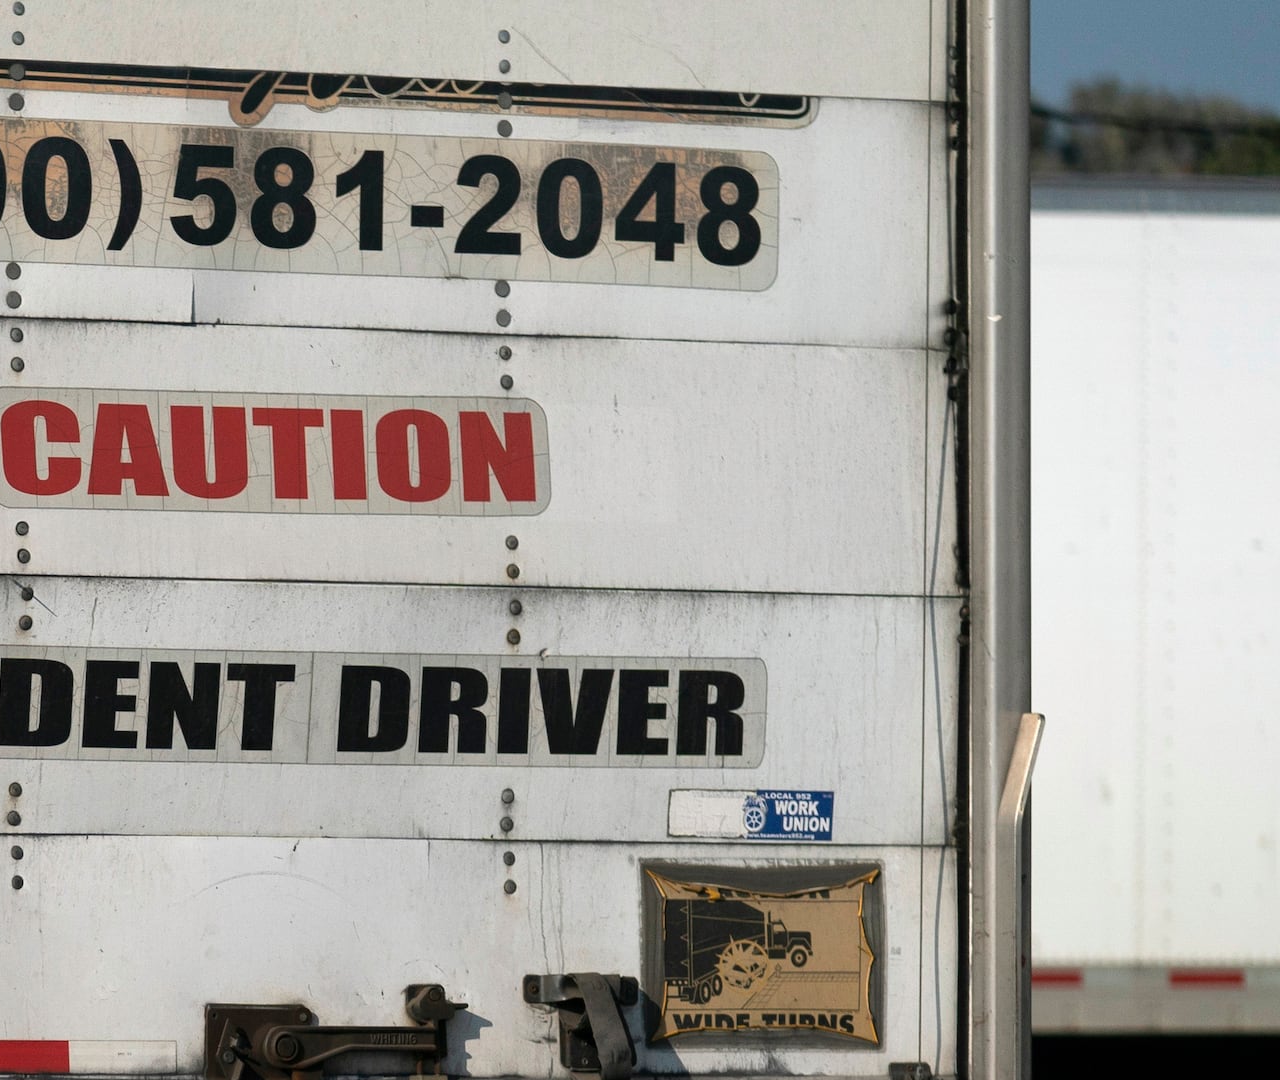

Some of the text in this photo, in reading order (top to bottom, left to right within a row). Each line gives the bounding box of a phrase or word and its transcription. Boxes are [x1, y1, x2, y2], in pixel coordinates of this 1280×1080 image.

[0, 399, 537, 503] CAUTION
[335, 665, 746, 757] DRIVER
[764, 791, 794, 800] LOCAL
[775, 800, 819, 816] WORK
[782, 816, 831, 832] UNION
